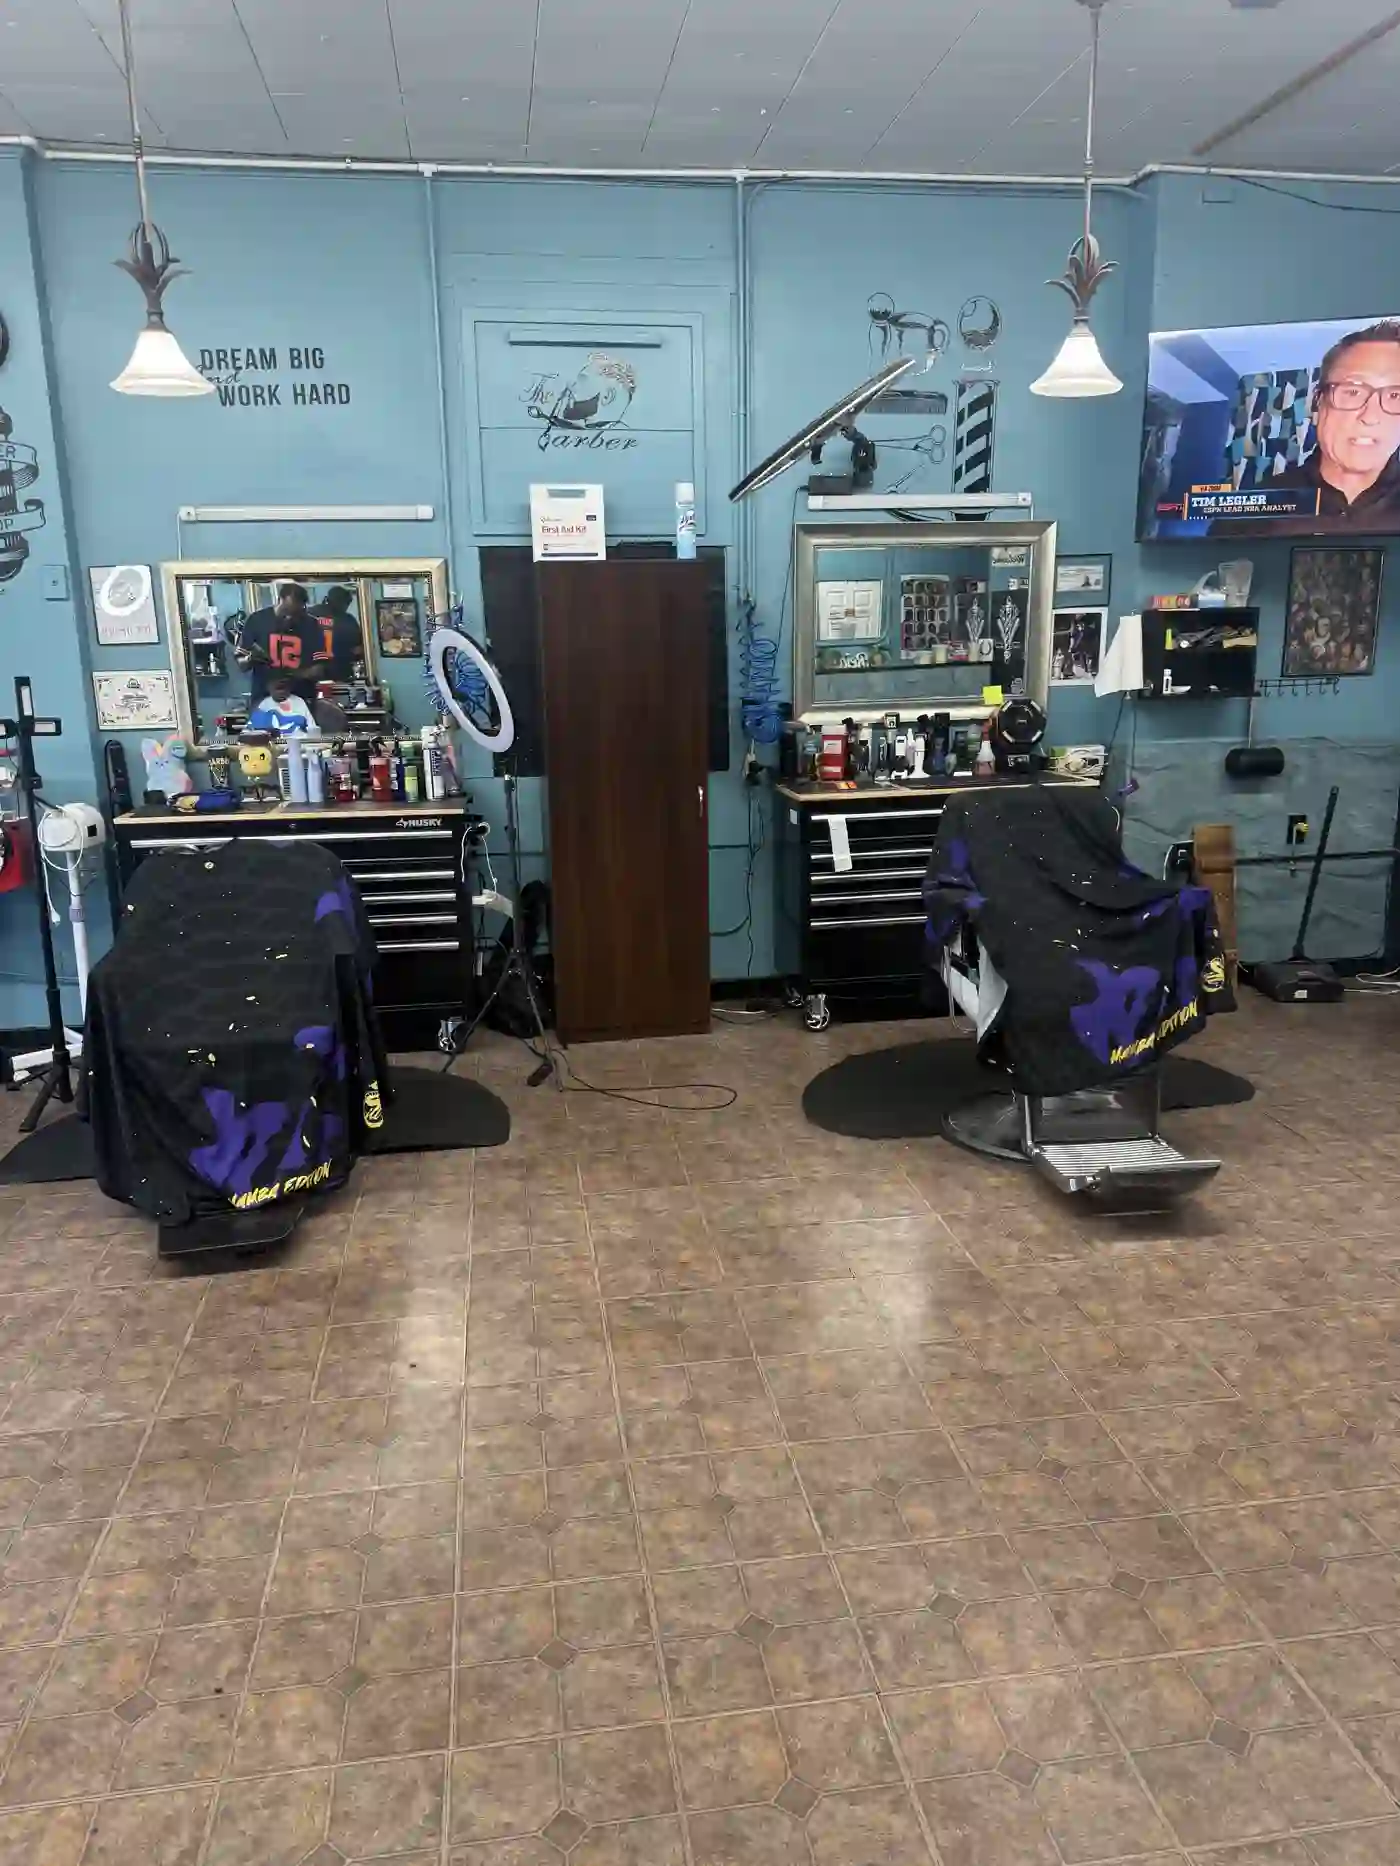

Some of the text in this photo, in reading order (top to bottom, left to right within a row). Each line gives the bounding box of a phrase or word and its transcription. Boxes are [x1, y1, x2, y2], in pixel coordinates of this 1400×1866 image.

[199, 347, 324, 371] DREAM BIG
[216, 381, 350, 407] WORK HARD
[518, 371, 559, 404] The
[1191, 494, 1267, 507] TIM LEGLER
[1261, 504, 1297, 512] ANALYST
[541, 525, 559, 534] First
[408, 818, 443, 828] HUSKY
[283, 1158, 333, 1193] EDITION
